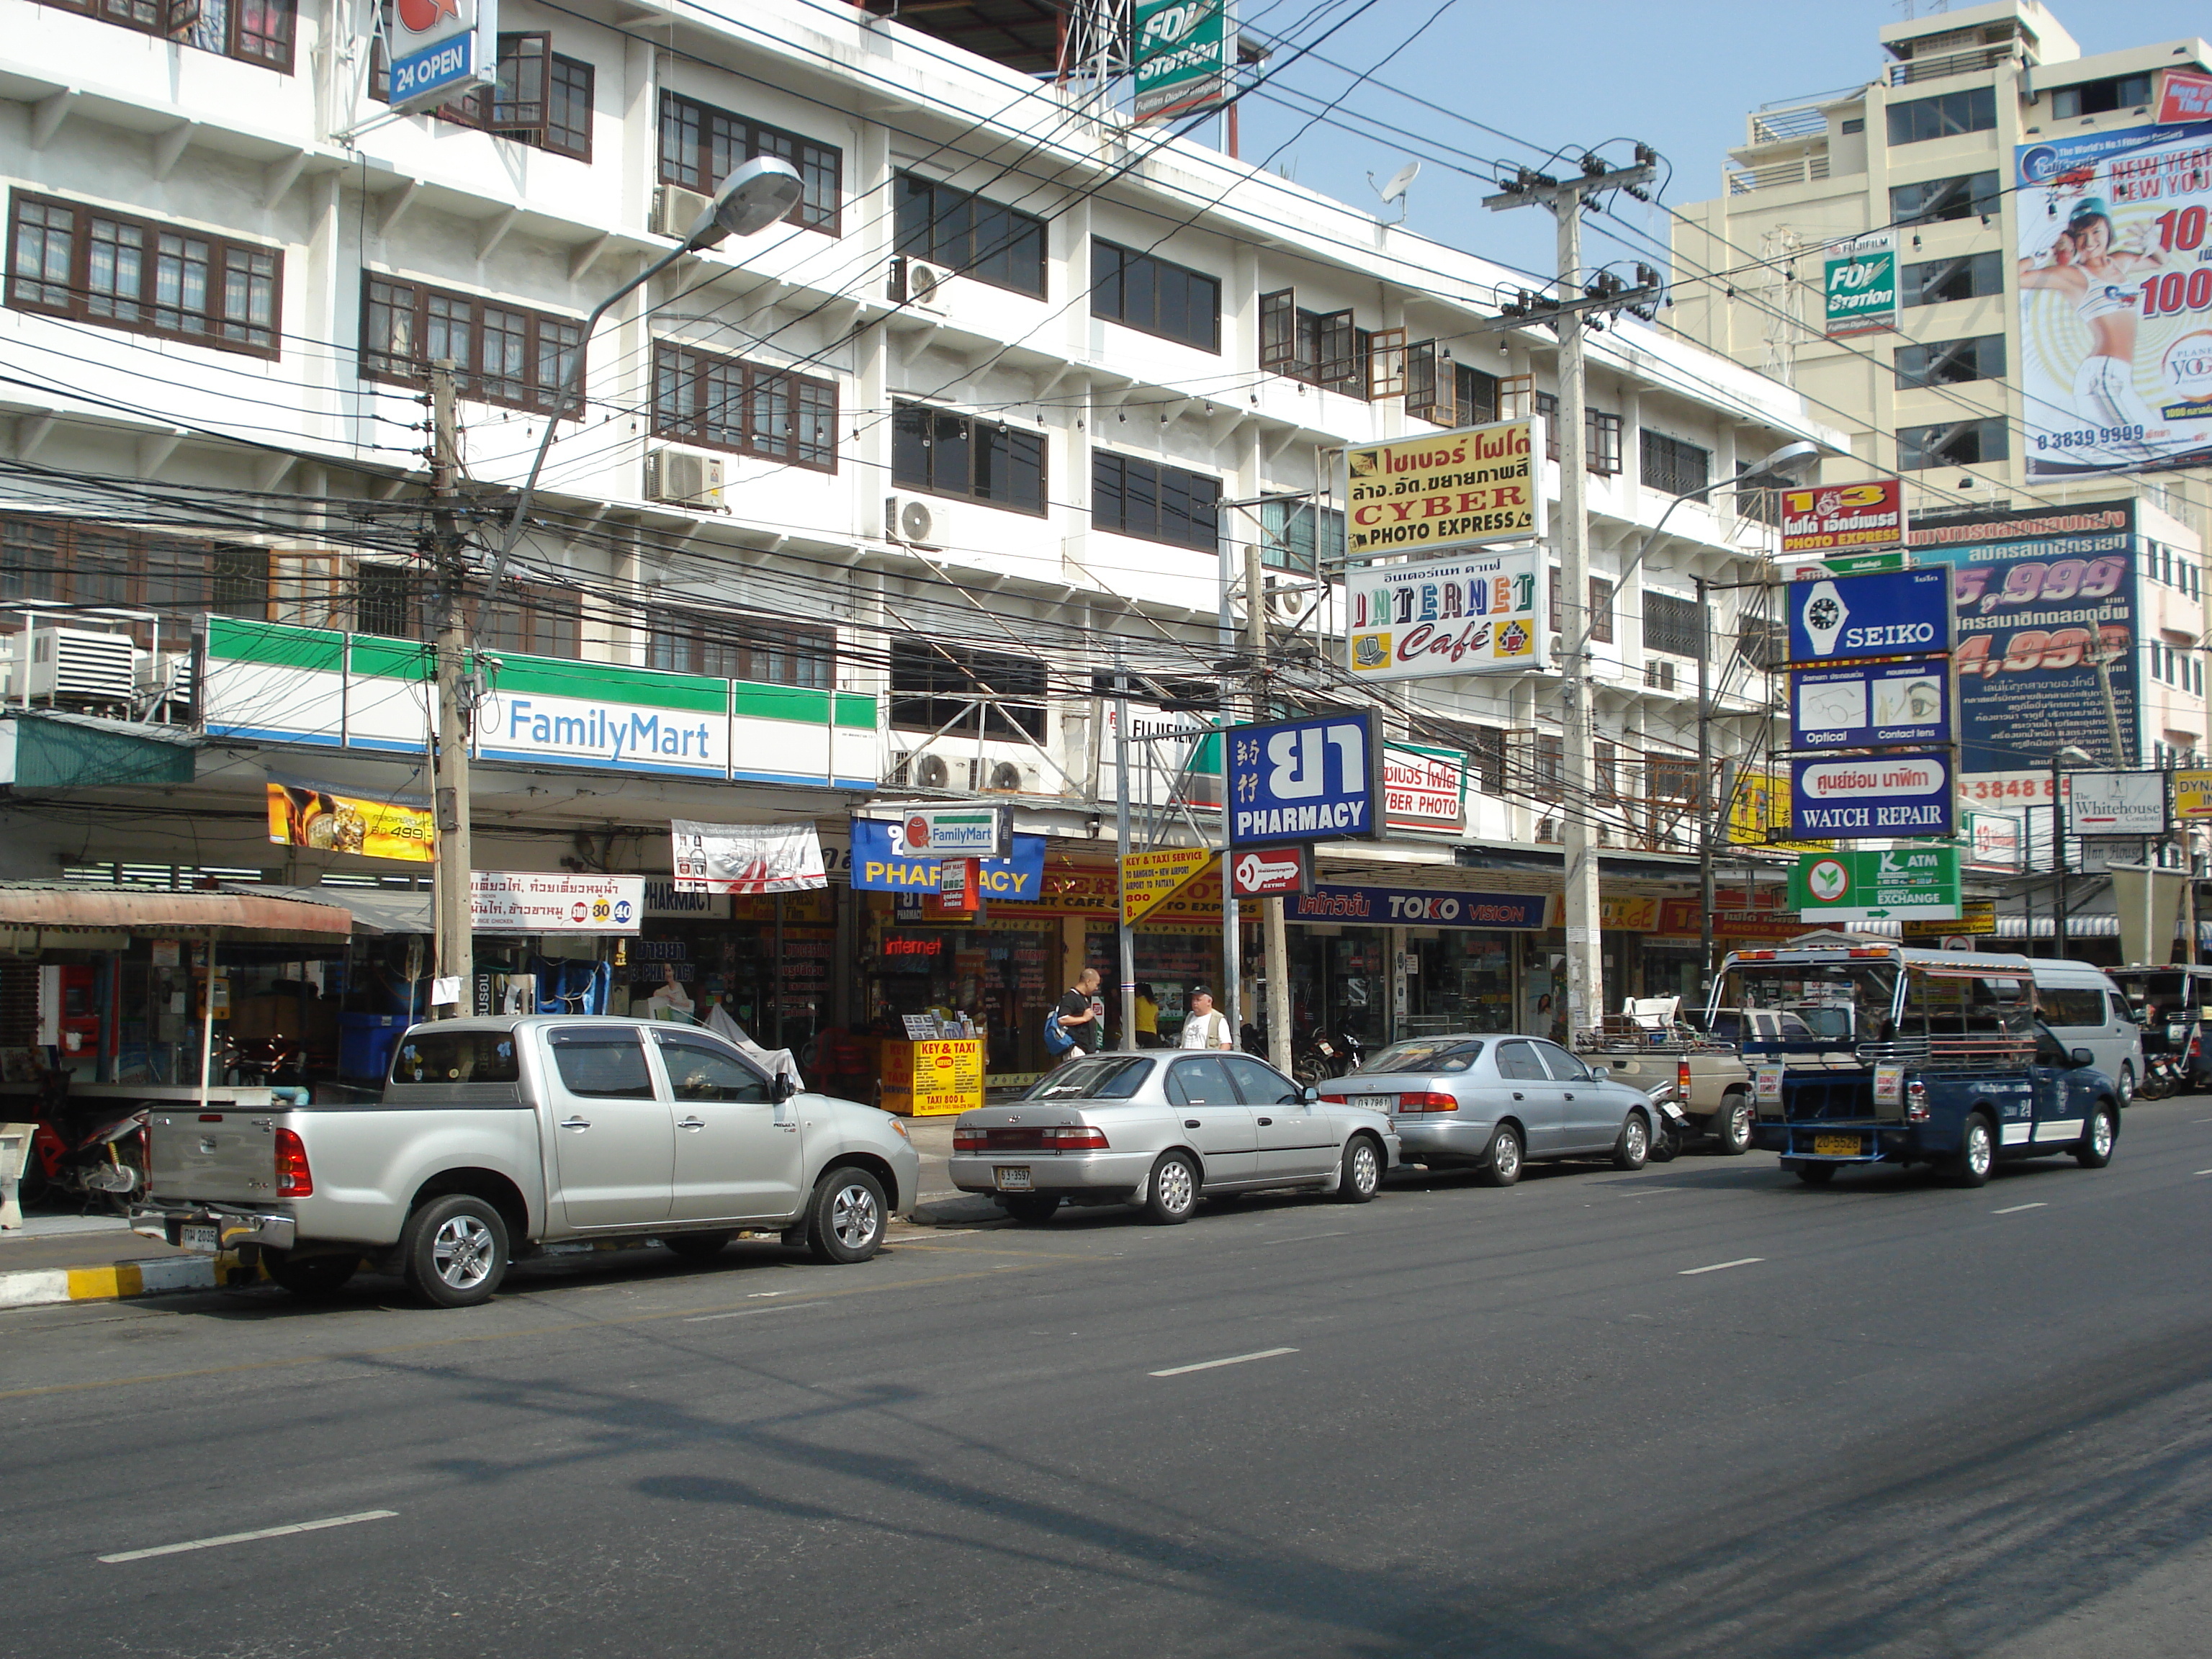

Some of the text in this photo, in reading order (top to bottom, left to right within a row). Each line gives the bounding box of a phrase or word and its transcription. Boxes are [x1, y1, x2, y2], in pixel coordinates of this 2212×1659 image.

[397, 45, 463, 93] 24 OPEN
[2059, 148, 2073, 156] The
[2074, 143, 2105, 156] World's
[2105, 140, 2122, 150] No.1
[2111, 156, 2160, 181] NEW
[2112, 178, 2161, 204] NEW
[1843, 237, 1889, 253] FUJIFILM
[2051, 430, 2095, 449] 3839
[1384, 438, 1468, 475] ไซเบอร์
[1354, 485, 1527, 526] CYBER
[1370, 511, 1514, 546] PHOTO EXPRESS
[1784, 528, 1901, 550] PHOTO EXPRESS
[1352, 571, 1535, 629] INTERNET
[1955, 606, 2130, 631] ัครสมาชิกตลอดชีพ
[1845, 622, 1935, 649] SEIKO
[510, 698, 710, 762] FamilyMart
[1806, 728, 1936, 745] Optical Contact lens
[1268, 724, 1364, 799] ยา
[1384, 763, 1423, 786] ซเบอร์
[1883, 768, 1930, 787] นาฬิกา
[1974, 779, 2036, 799] 3848
[2180, 780, 2212, 793] DYN
[1385, 792, 1457, 815] BER PHOTO
[2075, 801, 2161, 815] Whitehouse
[1237, 801, 1364, 837] PHARMACY
[1802, 804, 1943, 828] WATCH REPAIR
[932, 826, 992, 844] FamilyMart
[1126, 851, 1202, 866] KEY & TAXI SERVICE
[1881, 850, 1939, 873] K ATM
[866, 860, 1029, 894] PHAACY
[1125, 871, 1133, 879] TO
[1171, 866, 1190, 876] AIRPORT
[1126, 881, 1144, 890] AIRPORT
[1155, 878, 1175, 889] PATTAYA
[470, 900, 507, 915] มันไก่,
[1125, 894, 1151, 902] 800
[1877, 893, 1941, 905] EXCHANGE
[593, 904, 631, 919] 30 40
[1191, 902, 1256, 914] EXPSS
[1388, 895, 1526, 922] TOKO VISION
[1723, 923, 1771, 932] PHOTO
[636, 941, 687, 961] ขายยา
[786, 943, 832, 962] processing
[885, 935, 943, 956] internet
[1013, 949, 1050, 961] INTERNET
[644, 963, 696, 983] PHAACY
[922, 1043, 976, 1054] KEY & TAXI
[884, 1085, 912, 1094] SERVICE
[927, 1095, 942, 1104] TAXI
[1370, 1098, 1388, 1107] 7961
[2020, 1098, 2032, 1118] 24
[1817, 1136, 1860, 1149] 20-5528
